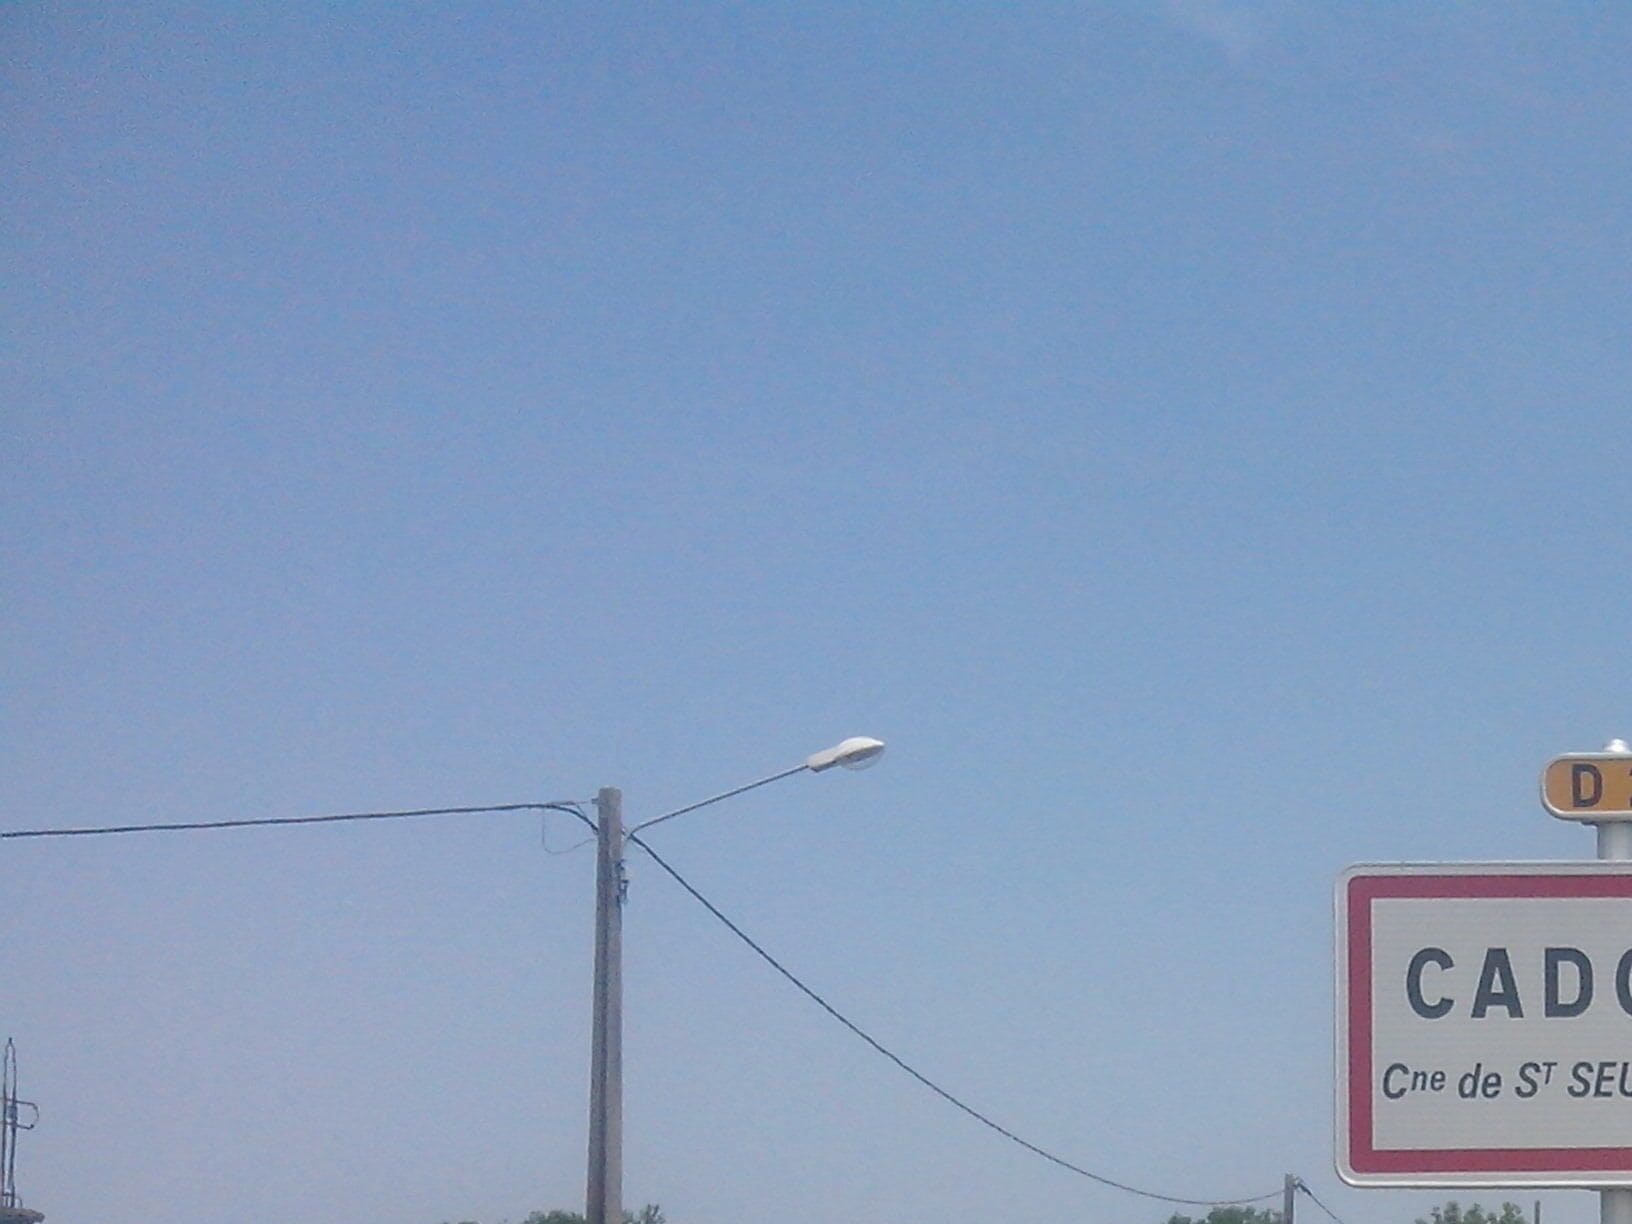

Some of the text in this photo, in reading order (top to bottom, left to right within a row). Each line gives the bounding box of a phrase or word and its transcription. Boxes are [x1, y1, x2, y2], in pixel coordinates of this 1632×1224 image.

[1572, 764, 1602, 807] D
[1383, 1063, 1446, 1099] Cne
[1458, 1063, 1501, 1098] de
